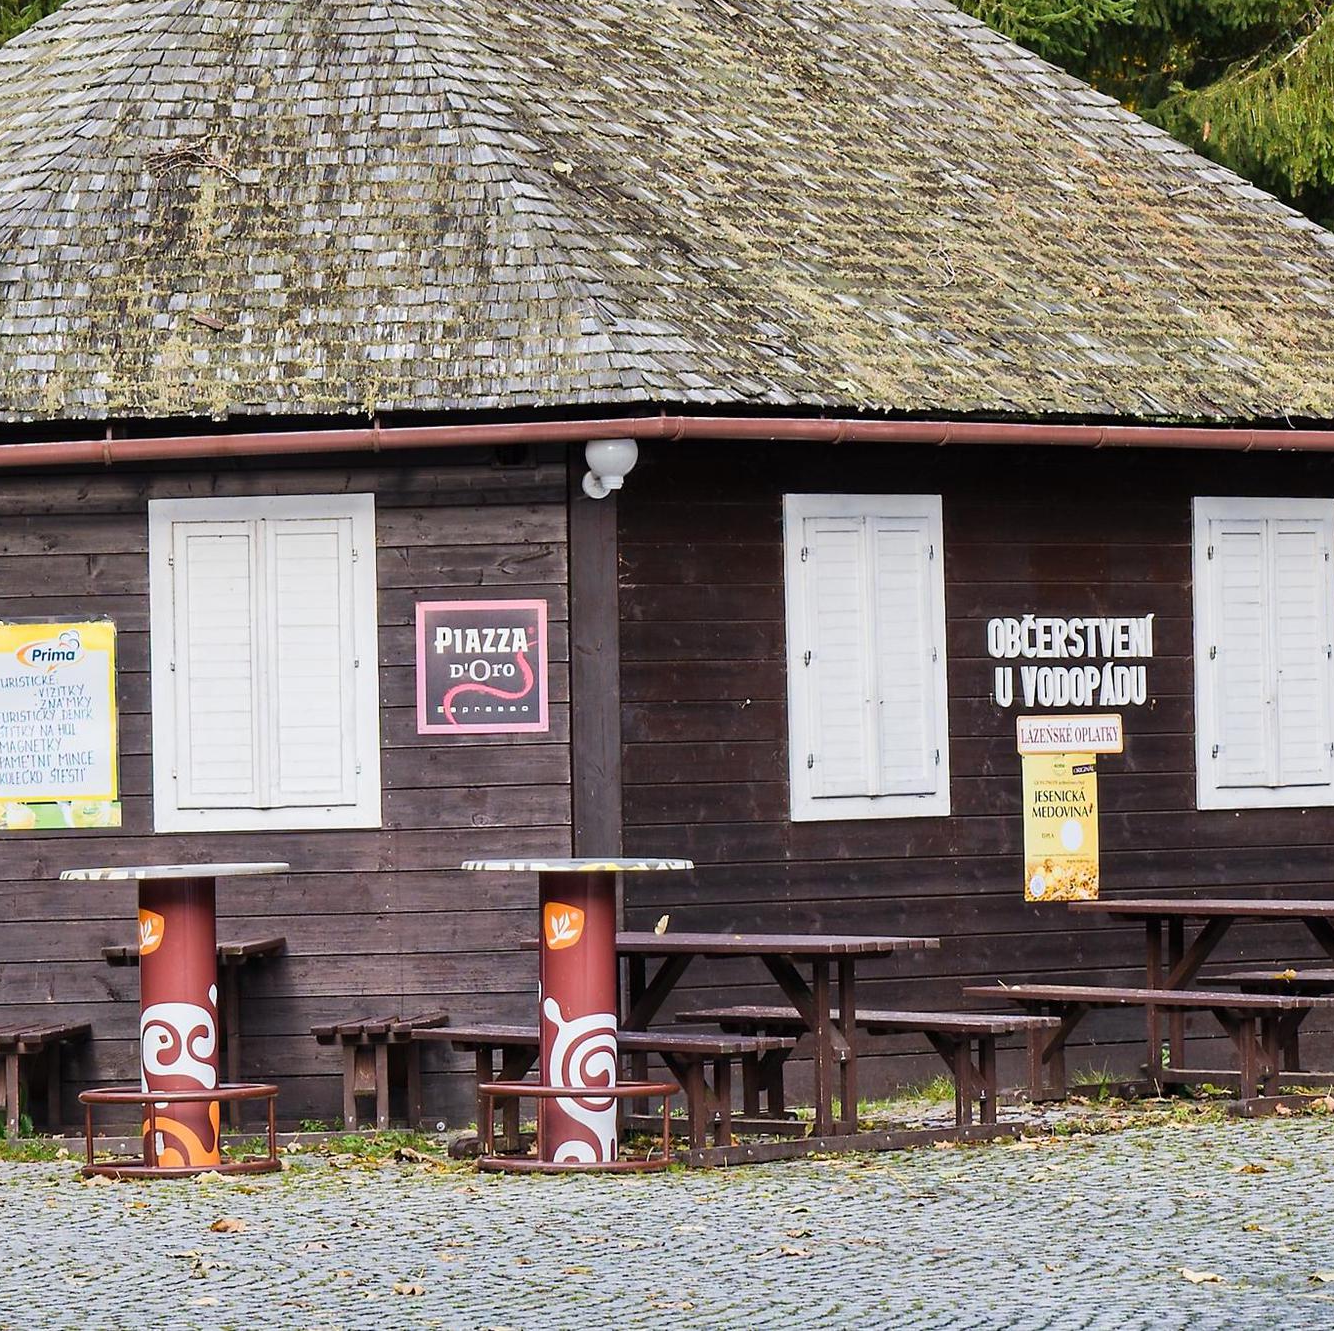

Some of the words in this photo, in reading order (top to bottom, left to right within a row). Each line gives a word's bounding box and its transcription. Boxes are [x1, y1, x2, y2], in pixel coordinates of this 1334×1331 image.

[434, 626, 529, 654] PIAZZA
[987, 613, 1155, 659] OBČERSTVENÍ
[32, 648, 75, 661] Prima
[994, 666, 1013, 707] U
[1021, 662, 1147, 707] VODOPÁDU
[1074, 726, 1119, 742] OPLATKY
[0, 738, 62, 753] MAGNETKY
[58, 751, 94, 766] MINCE
[1034, 787, 1086, 803] JESENICKÁ
[1032, 806, 1089, 818] MEDOVINA
